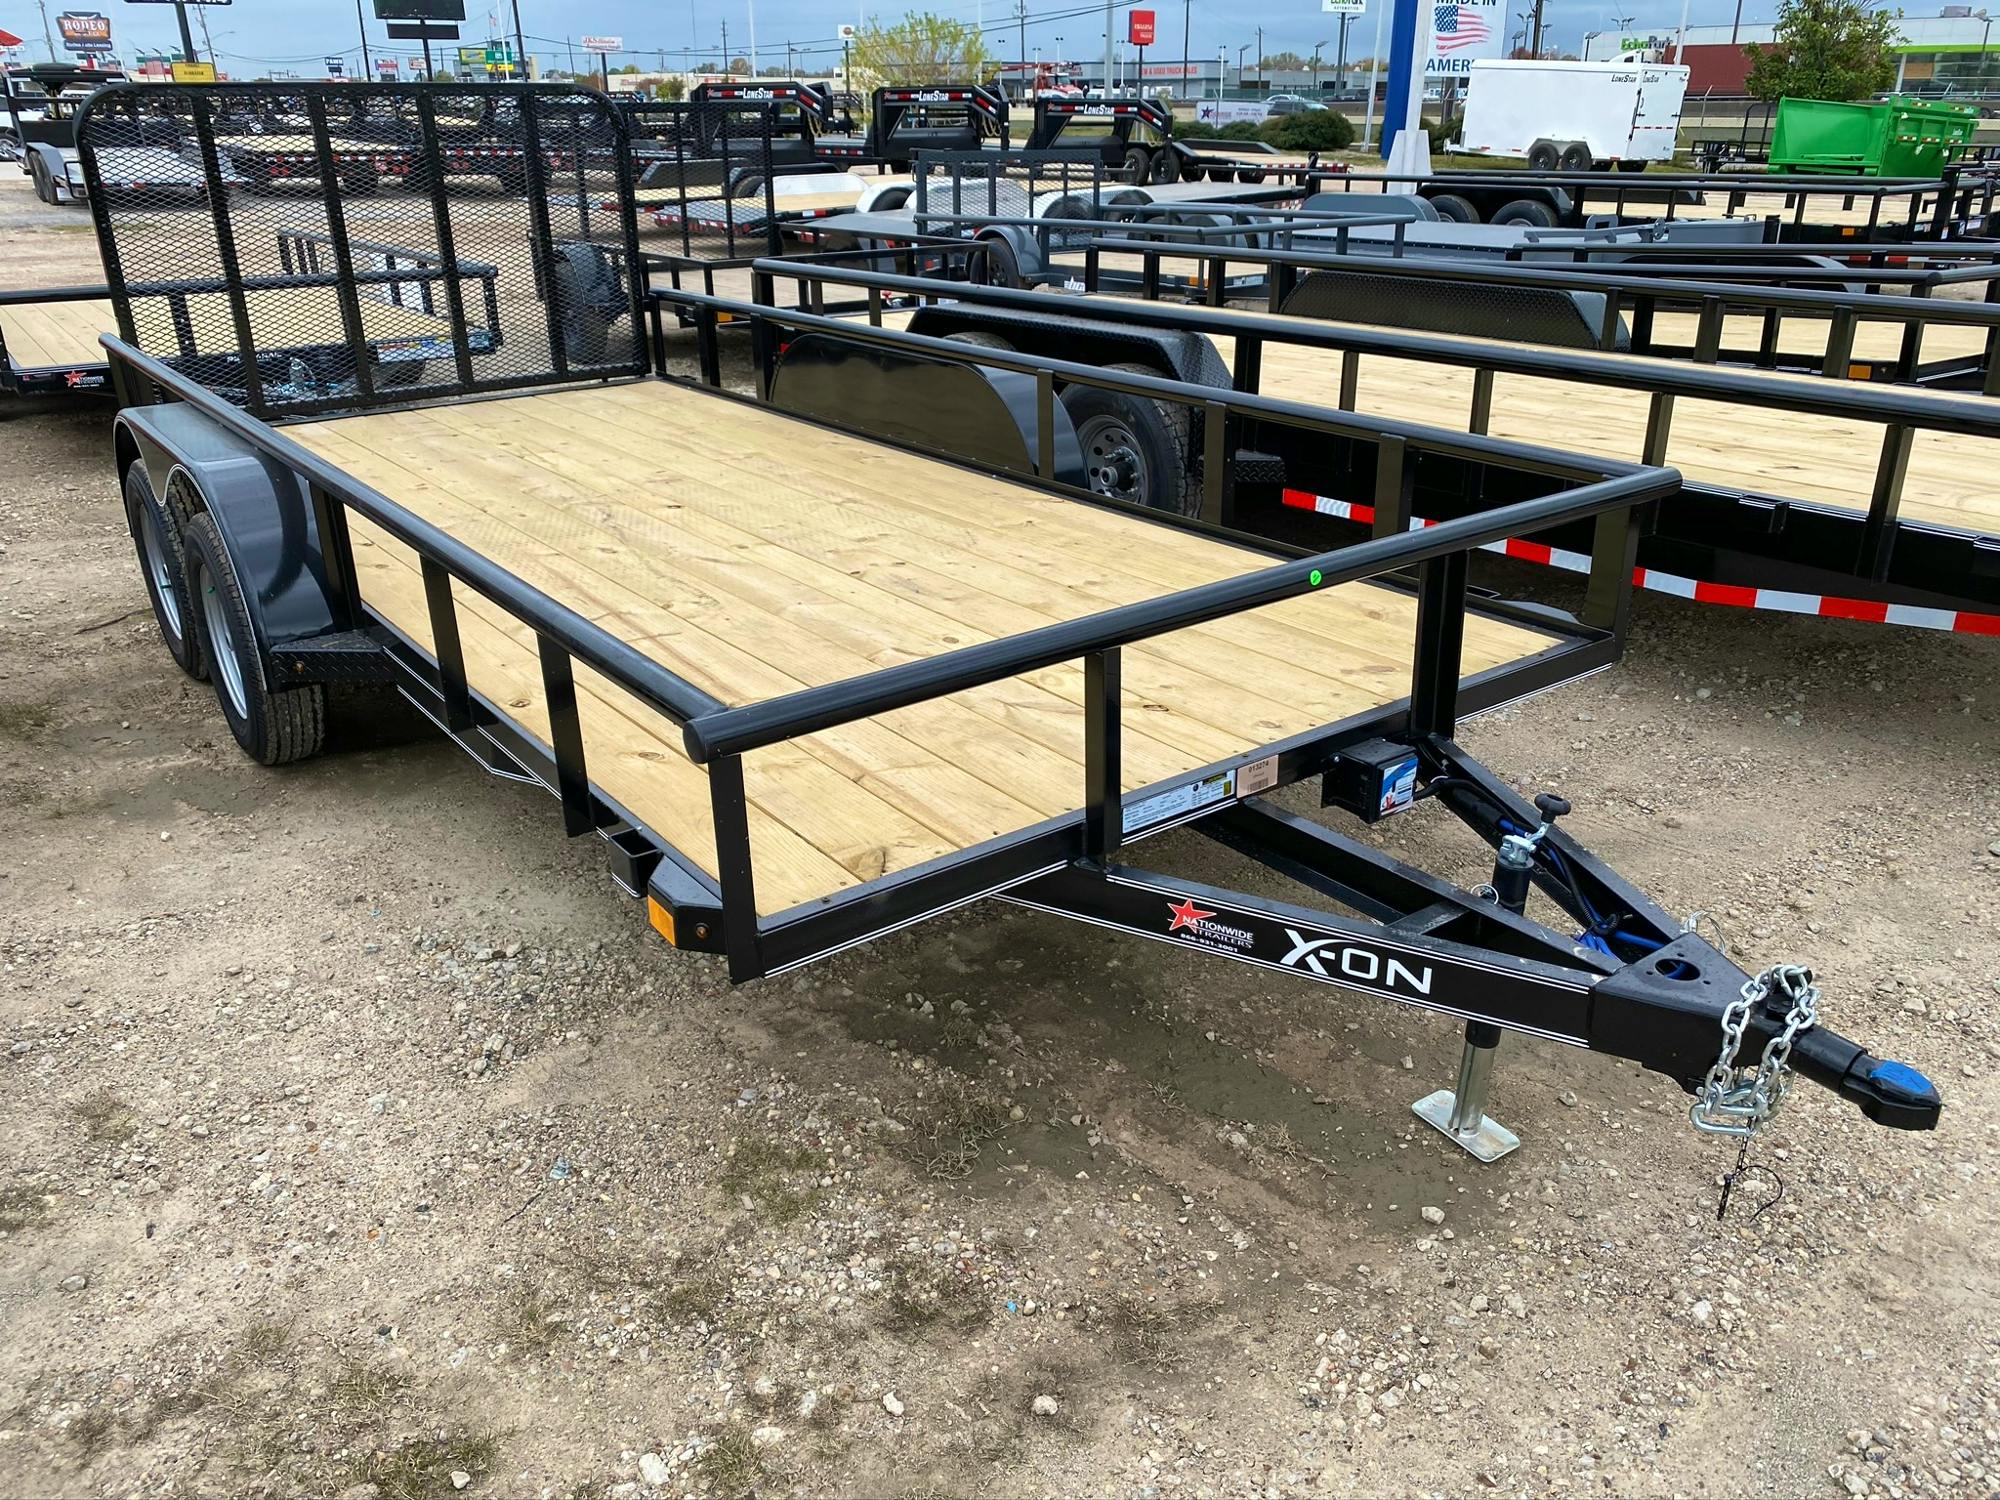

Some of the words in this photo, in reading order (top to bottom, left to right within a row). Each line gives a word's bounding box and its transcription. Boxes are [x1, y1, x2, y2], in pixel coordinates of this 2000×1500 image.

[63, 20, 105, 31] RODEO
[1621, 35, 1674, 50] EchoPark
[1425, 58, 1474, 72] AMER
[1182, 915, 1254, 940] NATIONWIDE
[1199, 929, 1252, 949] TRAILERS
[1280, 927, 1433, 995] X-ON
